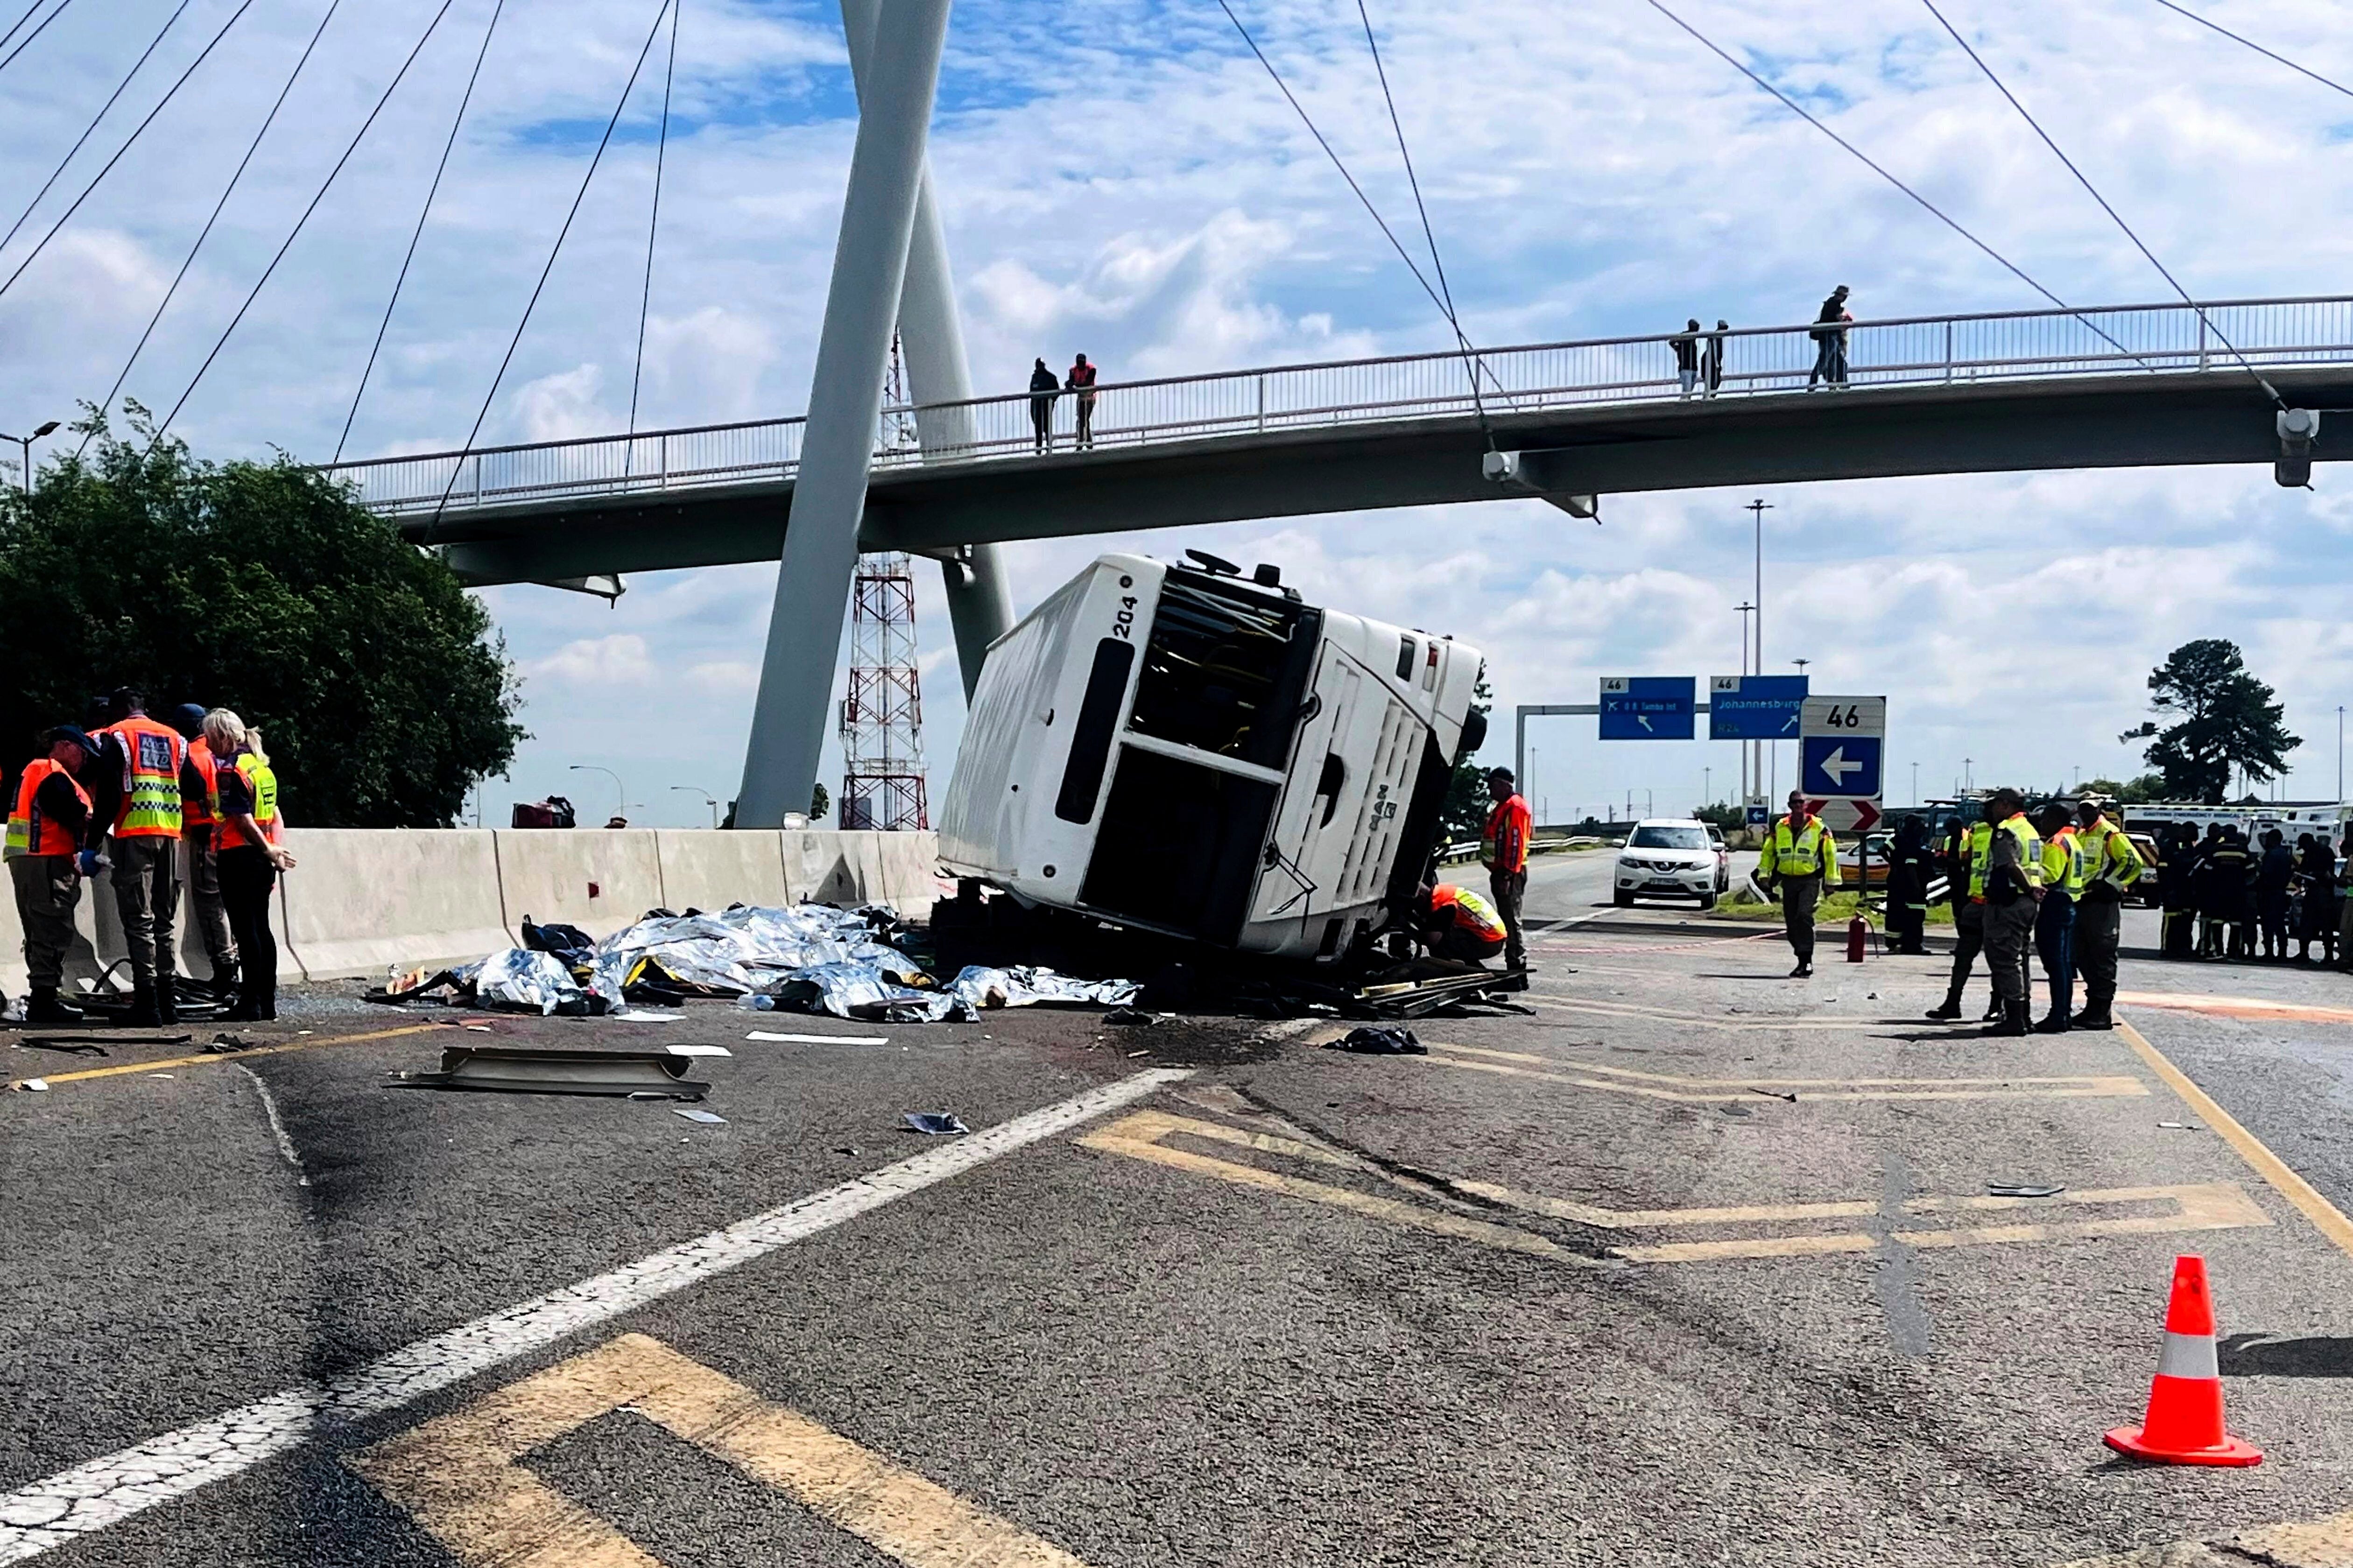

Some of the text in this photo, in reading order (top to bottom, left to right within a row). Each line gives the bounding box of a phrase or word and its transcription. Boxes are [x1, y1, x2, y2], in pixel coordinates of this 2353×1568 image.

[1113, 596, 1138, 639] 204
[1607, 680, 1621, 689] 46
[1718, 679, 1732, 689] 46
[1719, 699, 1801, 710] Johannesburg
[1827, 705, 1859, 727] 46
[1369, 784, 1389, 831] MAN
